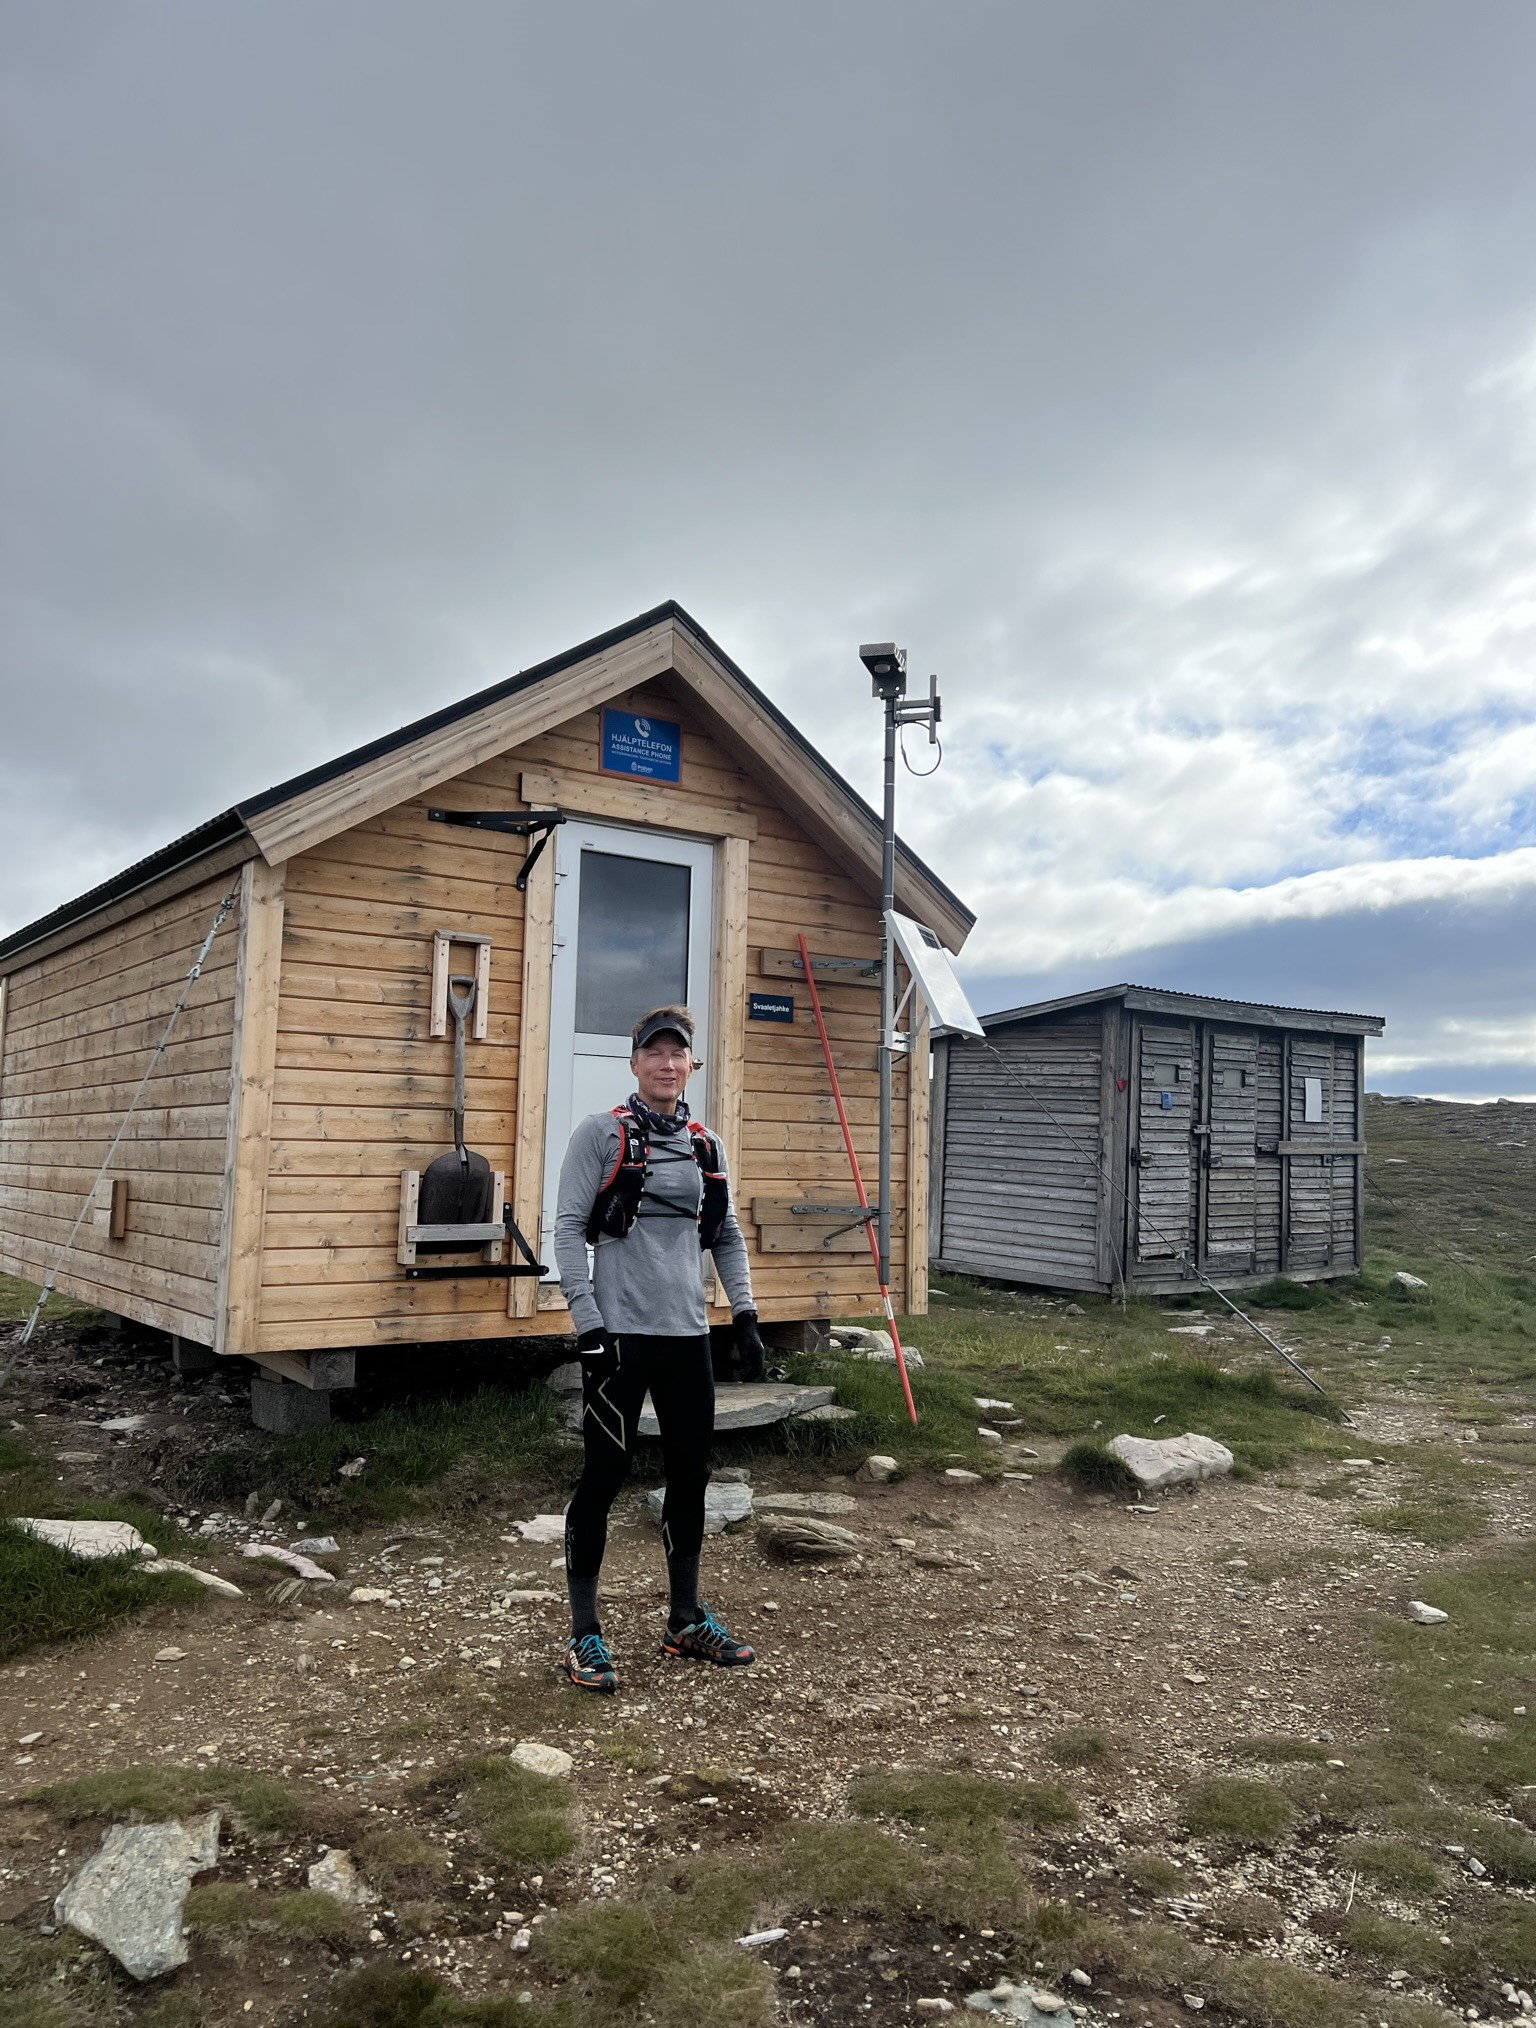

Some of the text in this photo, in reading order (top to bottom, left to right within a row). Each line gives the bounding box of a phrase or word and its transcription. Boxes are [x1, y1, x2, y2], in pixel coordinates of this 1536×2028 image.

[611, 733, 672, 753] HJÄLPTELEFON
[611, 743, 650, 757] ASSISTANCE
[650, 750, 672, 761] PHONE
